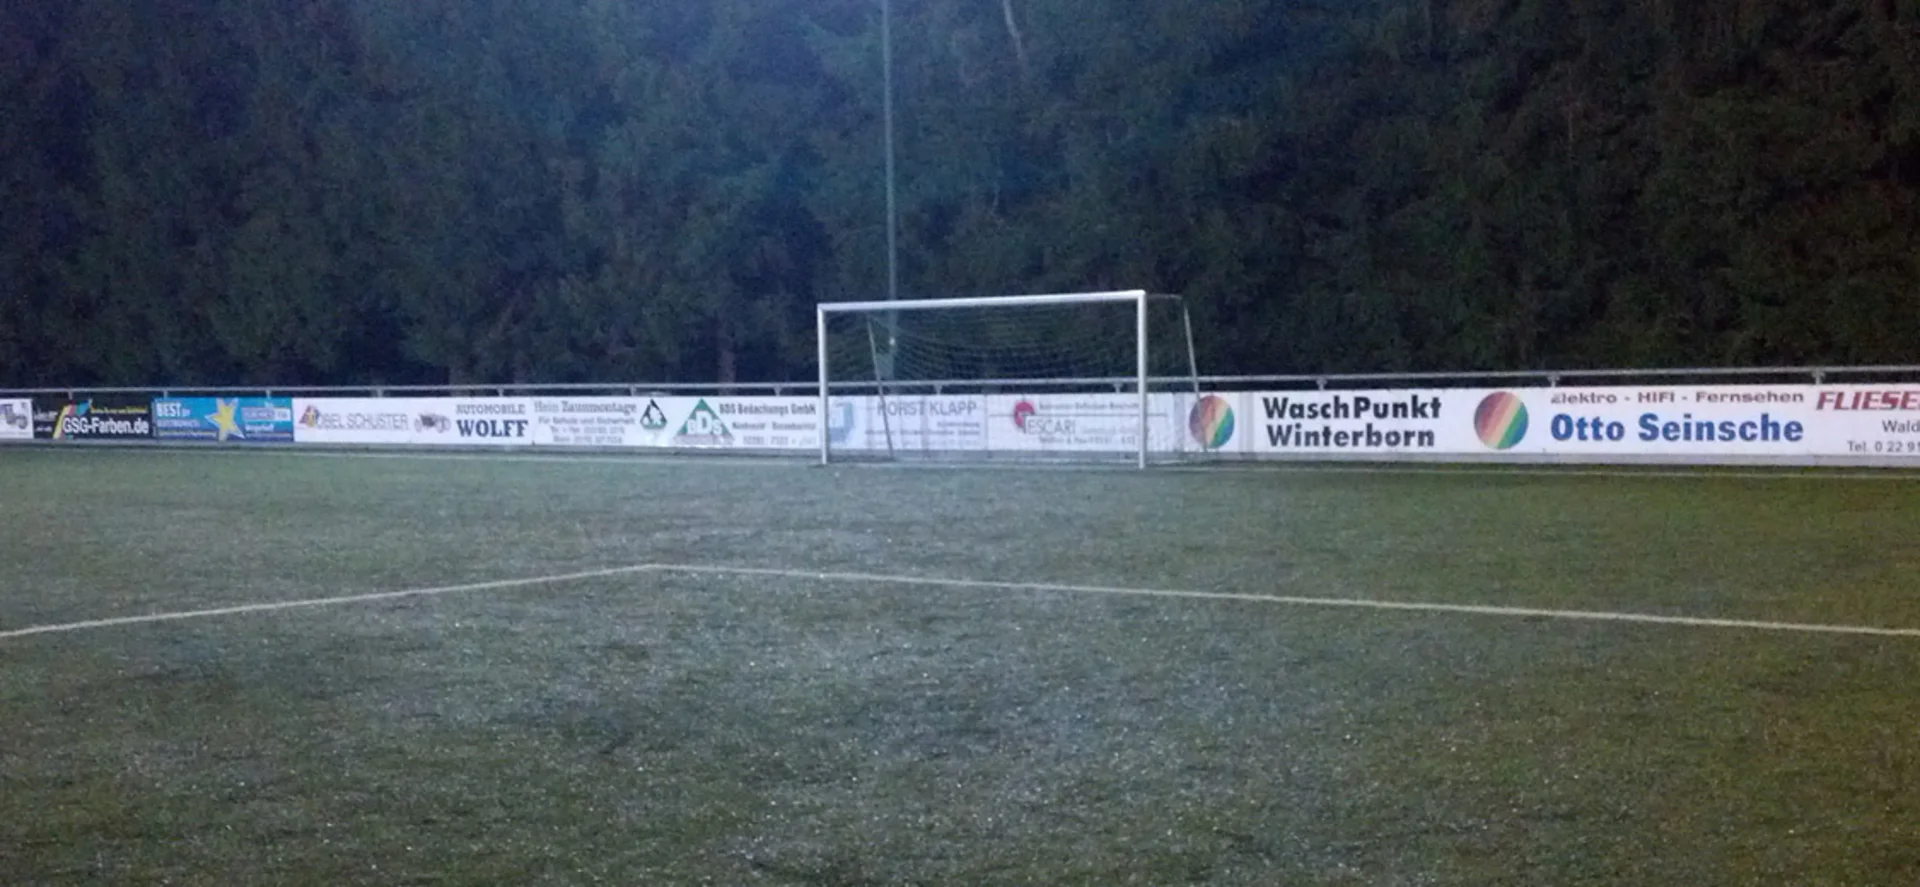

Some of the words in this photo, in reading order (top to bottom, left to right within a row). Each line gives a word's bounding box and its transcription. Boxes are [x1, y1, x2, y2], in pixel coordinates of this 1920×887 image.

[1696, 391, 1804, 403] Fernsehen
[1816, 390, 1920, 411] FLIESE
[157, 403, 181, 417] BEST
[456, 403, 526, 414] AUTOMOBILE
[929, 401, 977, 415] KLAPP
[1263, 395, 1442, 419] WaschPunkt
[63, 417, 149, 434] GSG-Farben.de
[456, 419, 529, 437] WOLFF
[1551, 413, 1625, 441] Otto
[1638, 412, 1804, 441] Seinsche
[1267, 423, 1436, 447] Winterborn
